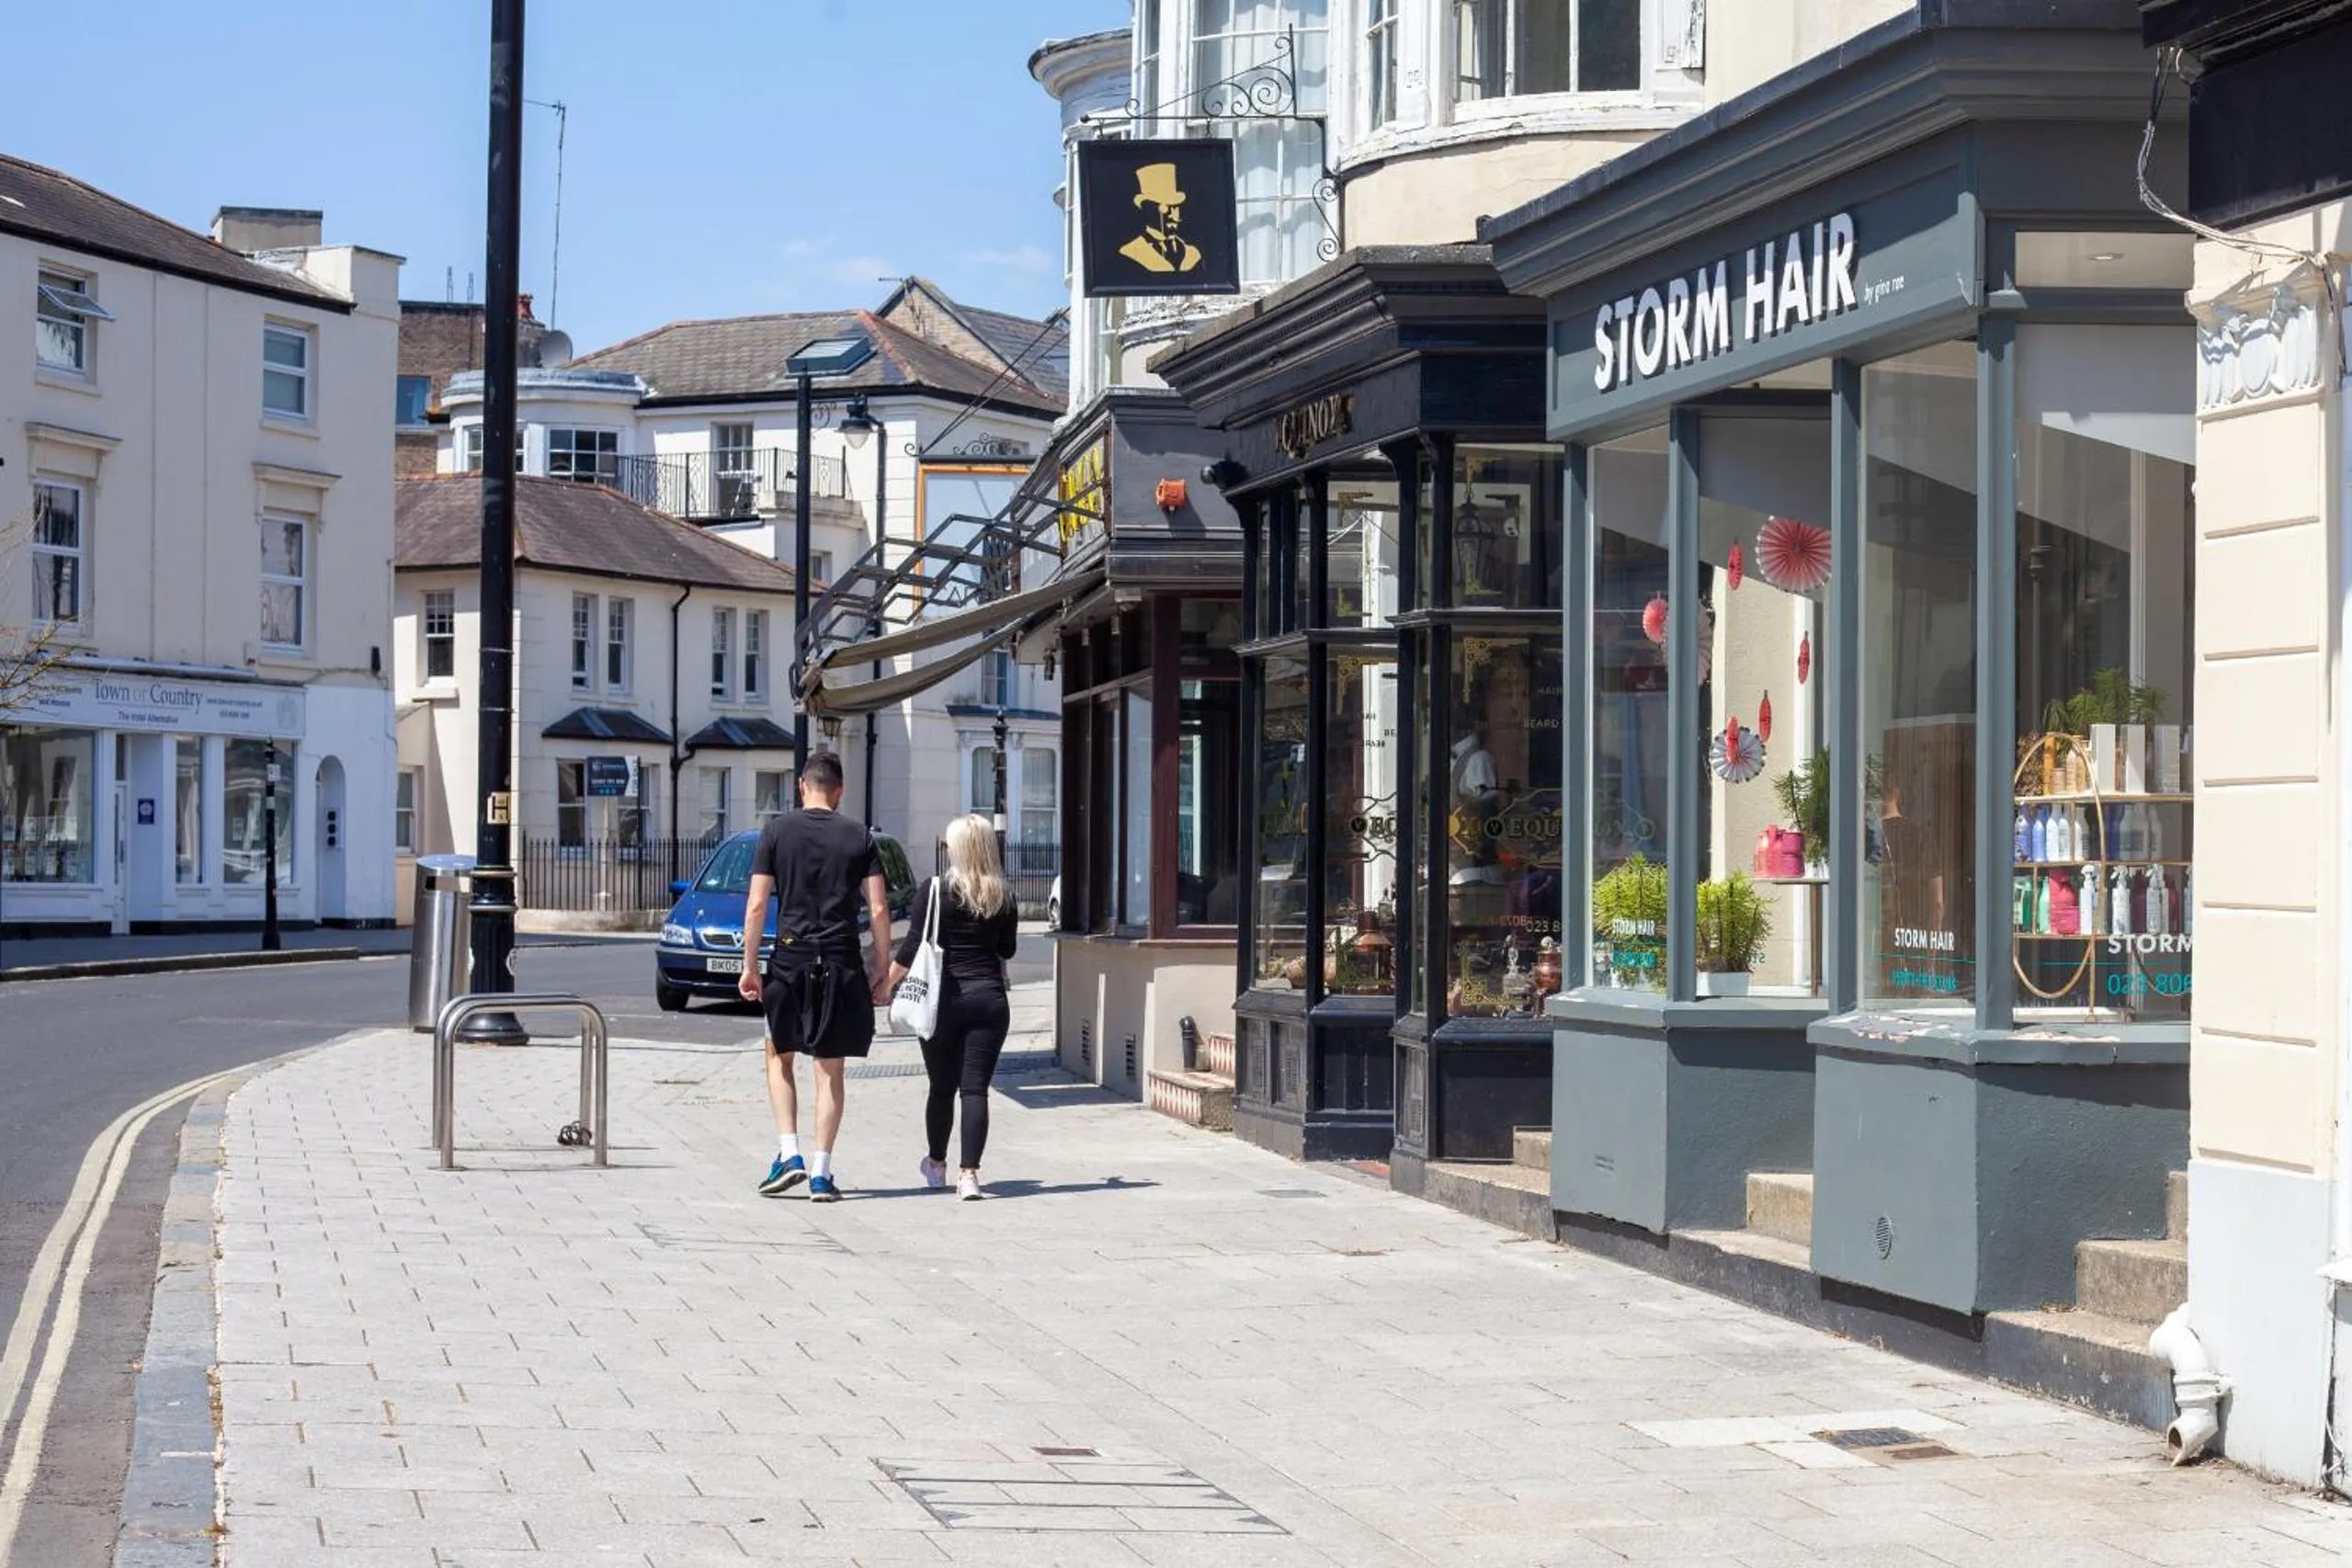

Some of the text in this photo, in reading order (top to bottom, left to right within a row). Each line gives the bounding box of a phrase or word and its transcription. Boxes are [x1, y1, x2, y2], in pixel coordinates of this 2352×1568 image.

[1594, 212, 1857, 390] STORM HAIR
[96, 678, 130, 700] Town
[132, 687, 146, 702] or
[150, 684, 201, 714] Country
[1894, 927, 1955, 951] STORM HAIR
